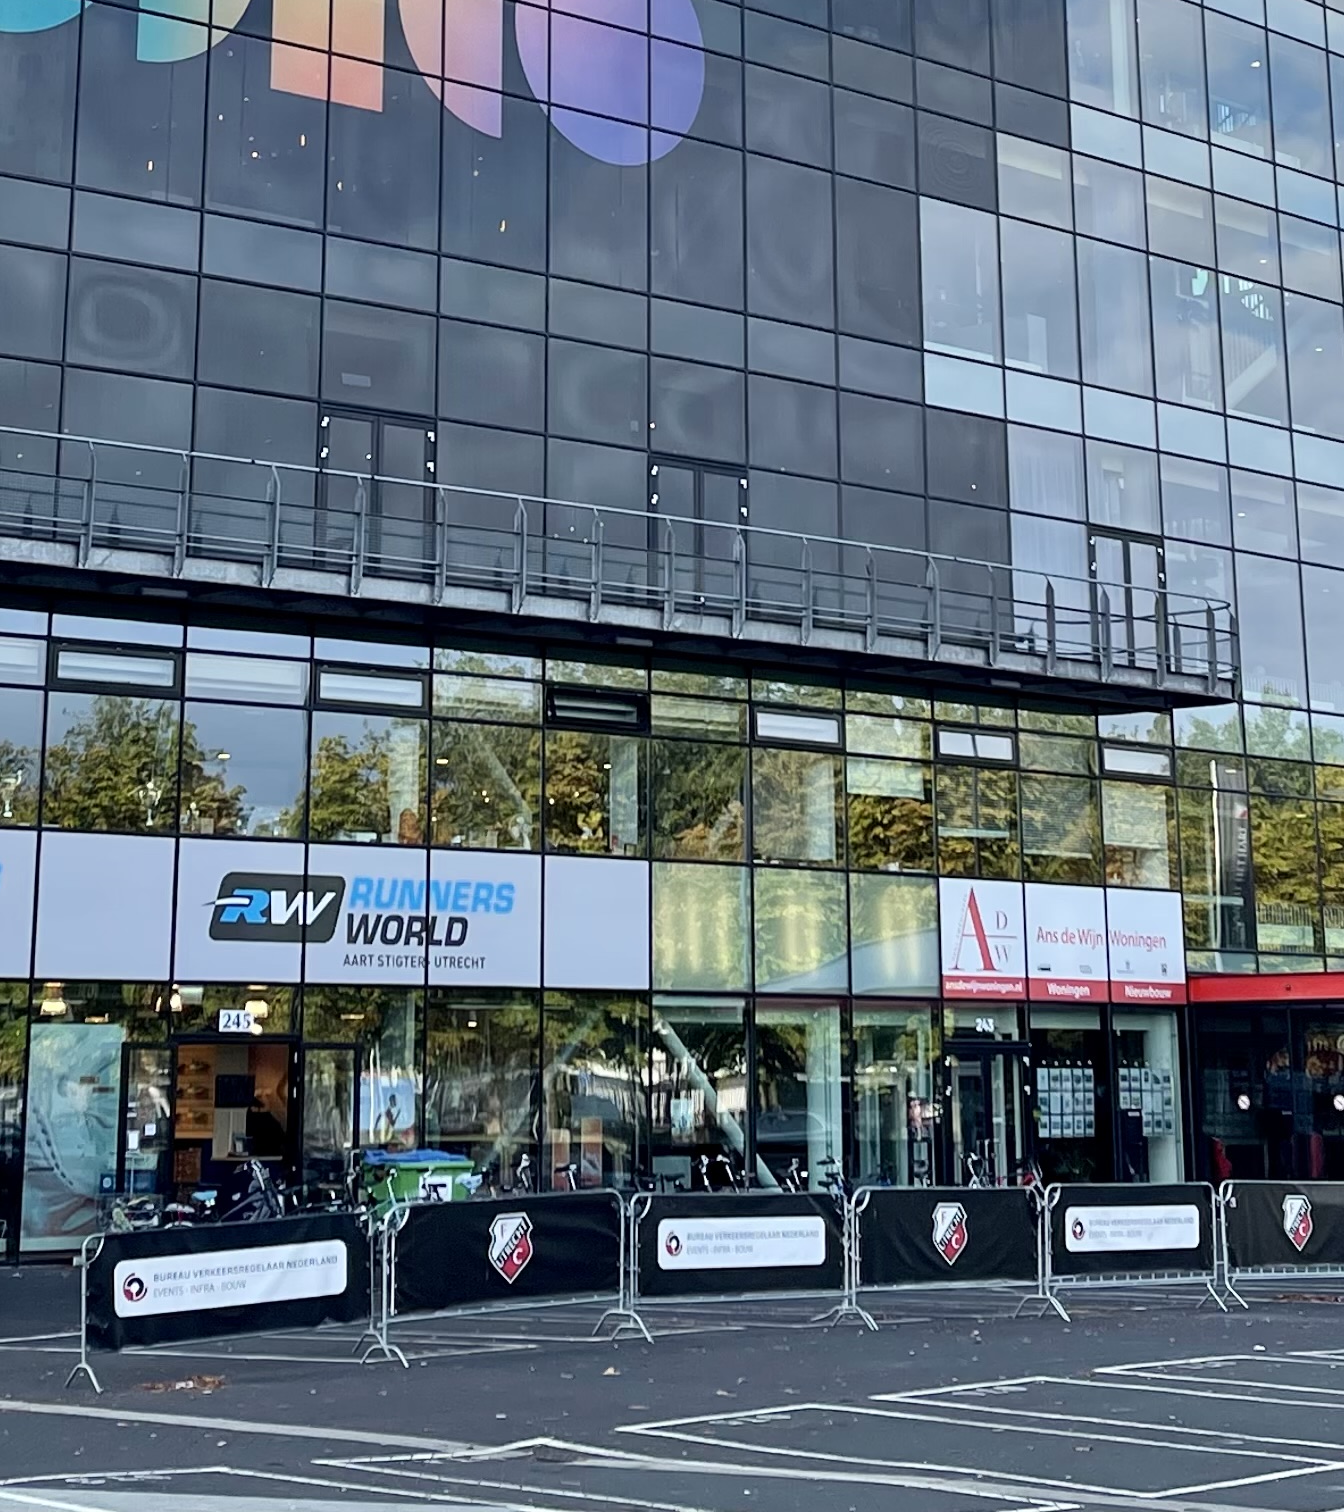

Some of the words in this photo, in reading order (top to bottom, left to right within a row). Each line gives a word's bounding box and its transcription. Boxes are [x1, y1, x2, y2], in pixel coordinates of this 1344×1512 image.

[349, 876, 516, 914] RUNNERS
[219, 888, 336, 925] RW
[347, 913, 468, 947] WORLD
[996, 910, 1008, 931] D
[1036, 926, 1059, 945] Ans
[1061, 926, 1076, 945] de
[1077, 928, 1105, 950] Wijn
[1108, 929, 1167, 952] Woningen
[343, 954, 374, 968] AART
[377, 955, 426, 969] STIGTER
[434, 956, 486, 970] UTRECHT
[994, 944, 1012, 964] W
[1047, 982, 1090, 999] Woningen
[1124, 984, 1172, 999] Nieuwbouw
[222, 1012, 251, 1029] 245
[975, 1018, 994, 1033] 243
[951, 1233, 961, 1249] C
[513, 1247, 523, 1265] C
[154, 1272, 190, 1283] BUREAU
[193, 1259, 285, 1279] VERKEERSREGELAAR
[286, 1255, 338, 1270] NEDERLAND
[154, 1286, 184, 1299] EVENTS
[190, 1282, 215, 1294] INFRA
[221, 1280, 247, 1291] BOUW
